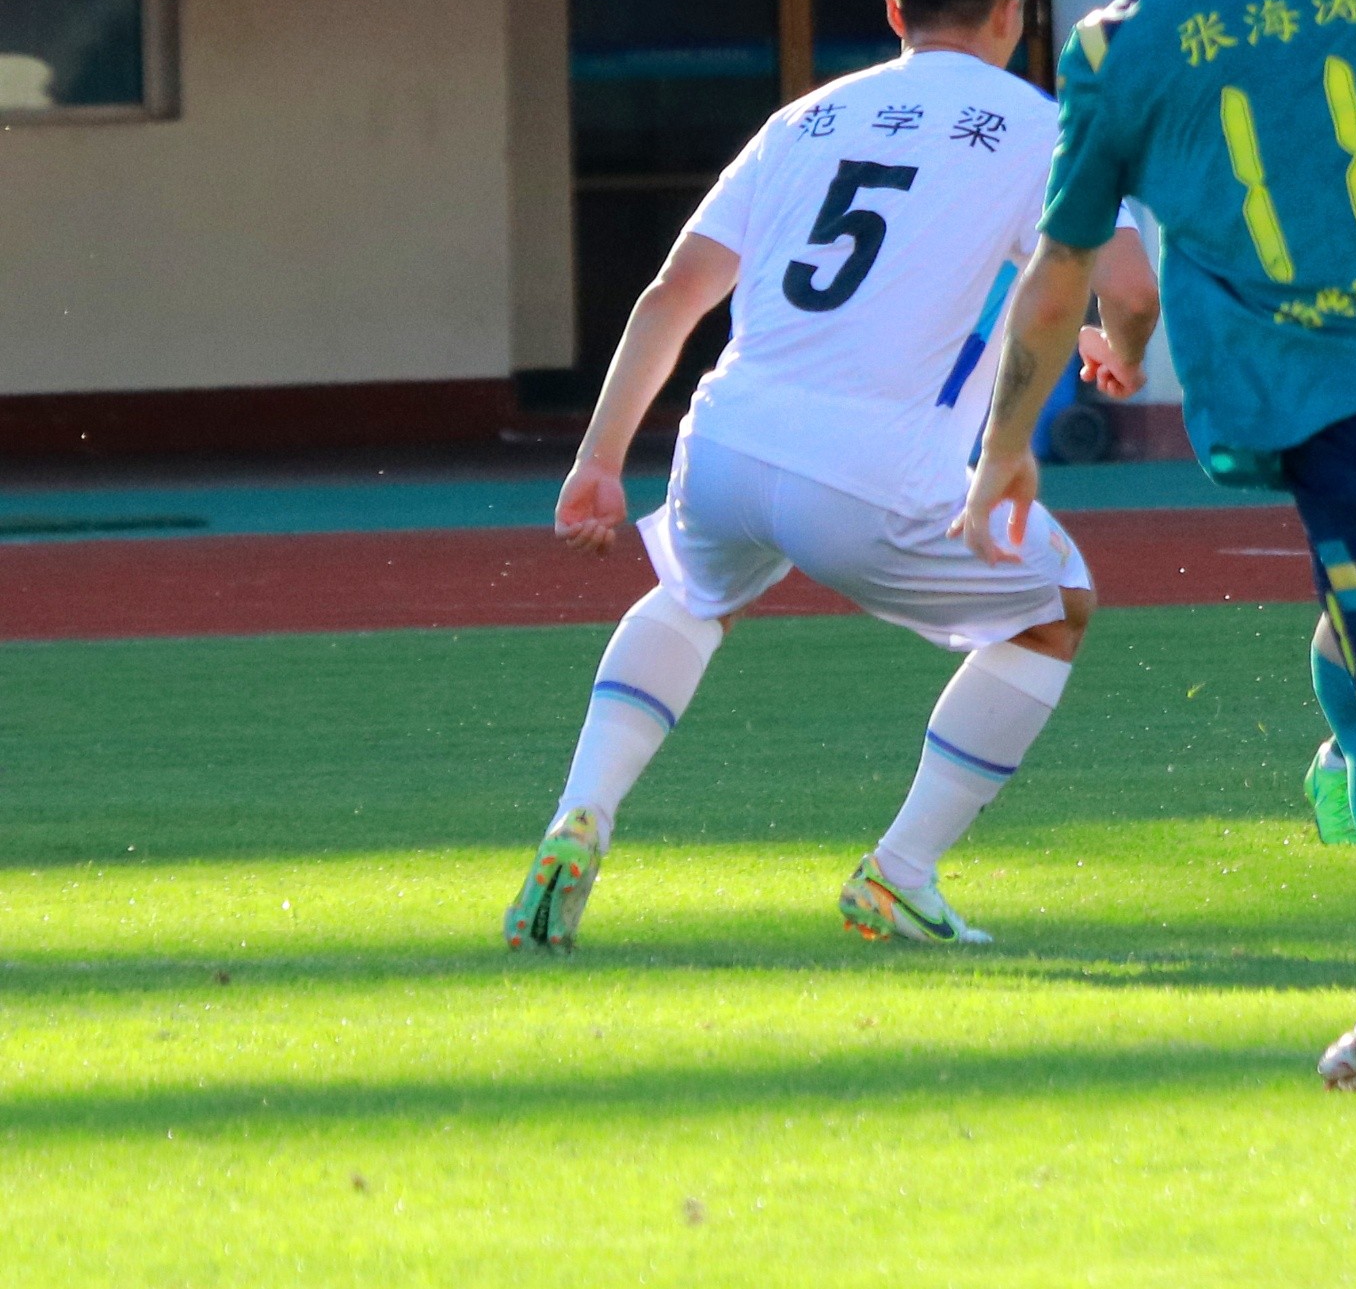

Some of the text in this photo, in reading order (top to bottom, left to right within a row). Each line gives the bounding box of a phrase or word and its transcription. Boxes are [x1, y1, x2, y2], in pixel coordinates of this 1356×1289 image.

[797, 103, 1007, 153] 范学梁
[782, 159, 919, 313] 5
